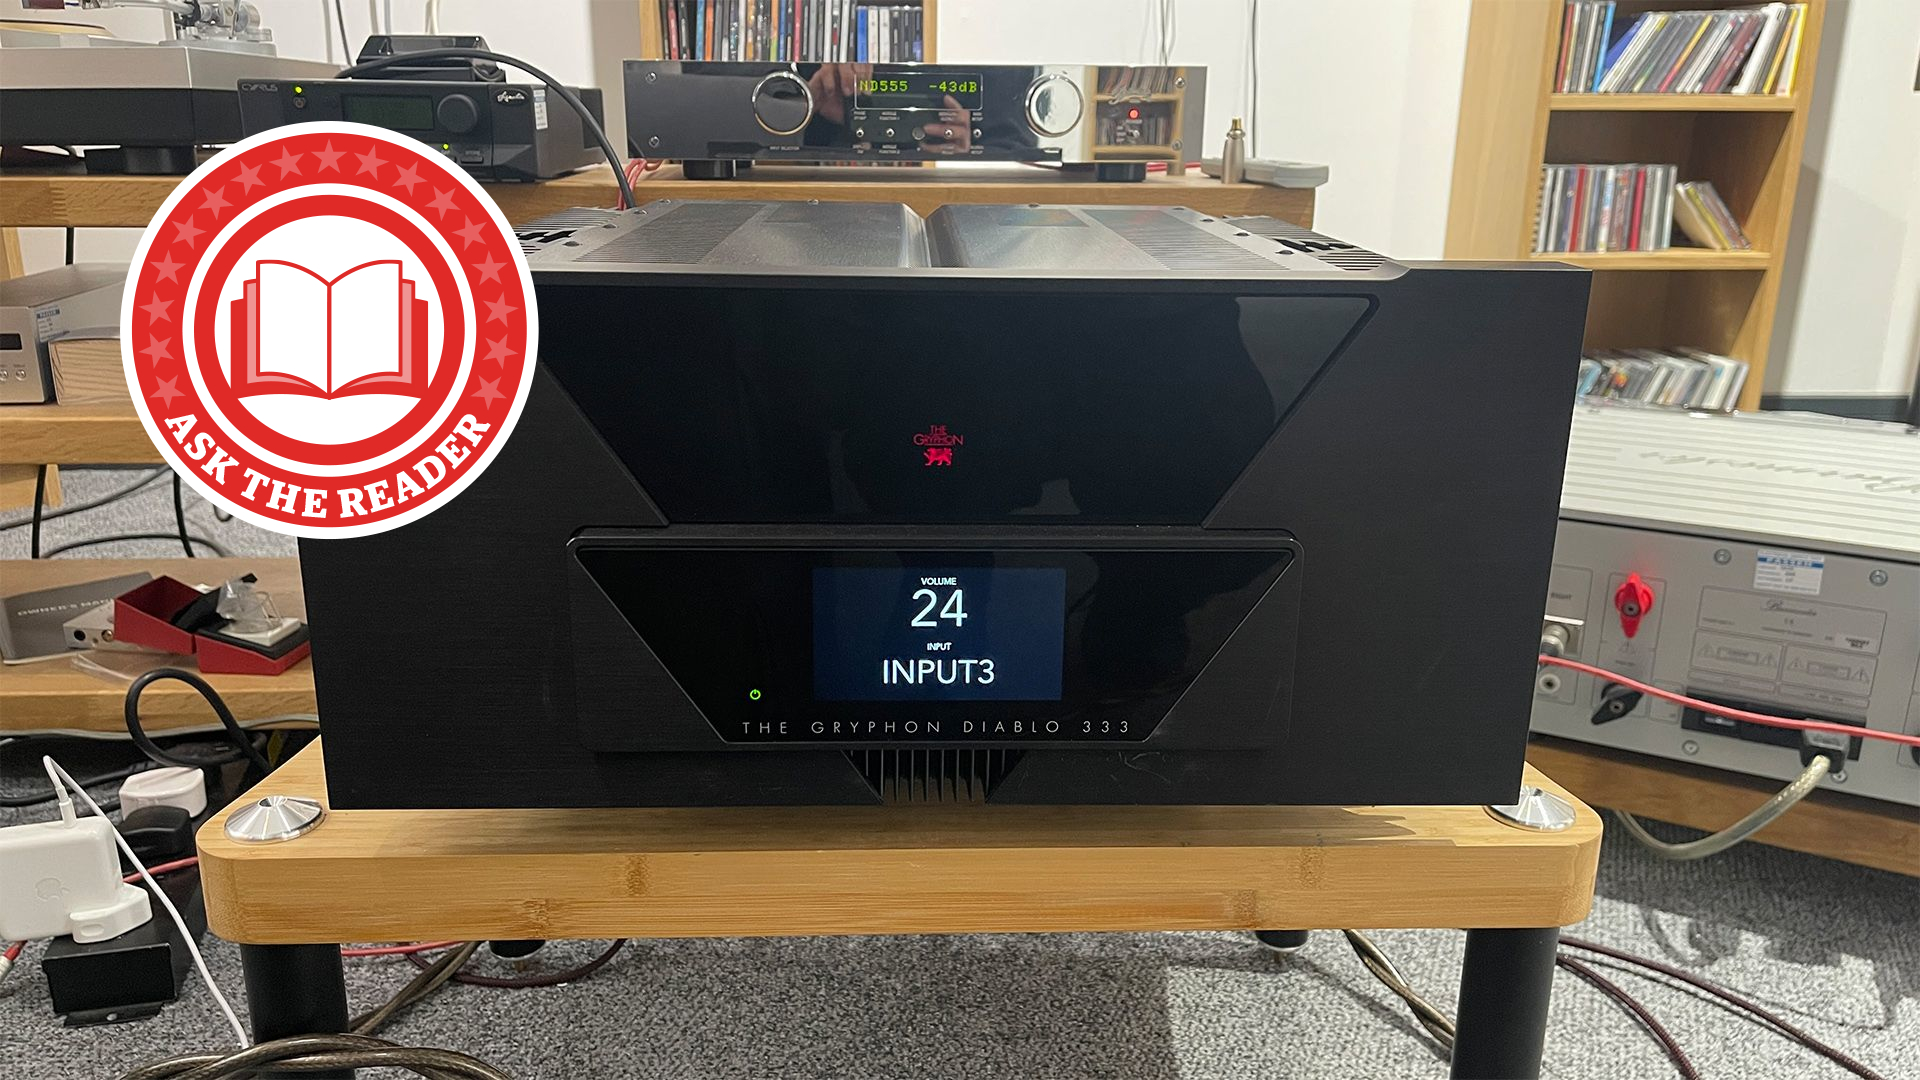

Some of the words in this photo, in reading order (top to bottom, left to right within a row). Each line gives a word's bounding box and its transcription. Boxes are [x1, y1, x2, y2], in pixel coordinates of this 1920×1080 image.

[859, 80, 909, 92] ND555
[928, 81, 978, 93] -43dB
[930, 424, 948, 435] THE
[913, 433, 964, 446] GRYPHON
[920, 577, 958, 586] VOLUME
[911, 588, 968, 628] 24
[926, 642, 953, 651] INPUT
[883, 659, 995, 685] INPUT3
[742, 721, 788, 734] THE
[811, 721, 940, 734] GRYPHON
[963, 720, 1059, 734] DIABLO
[1082, 720, 1129, 734] 333
